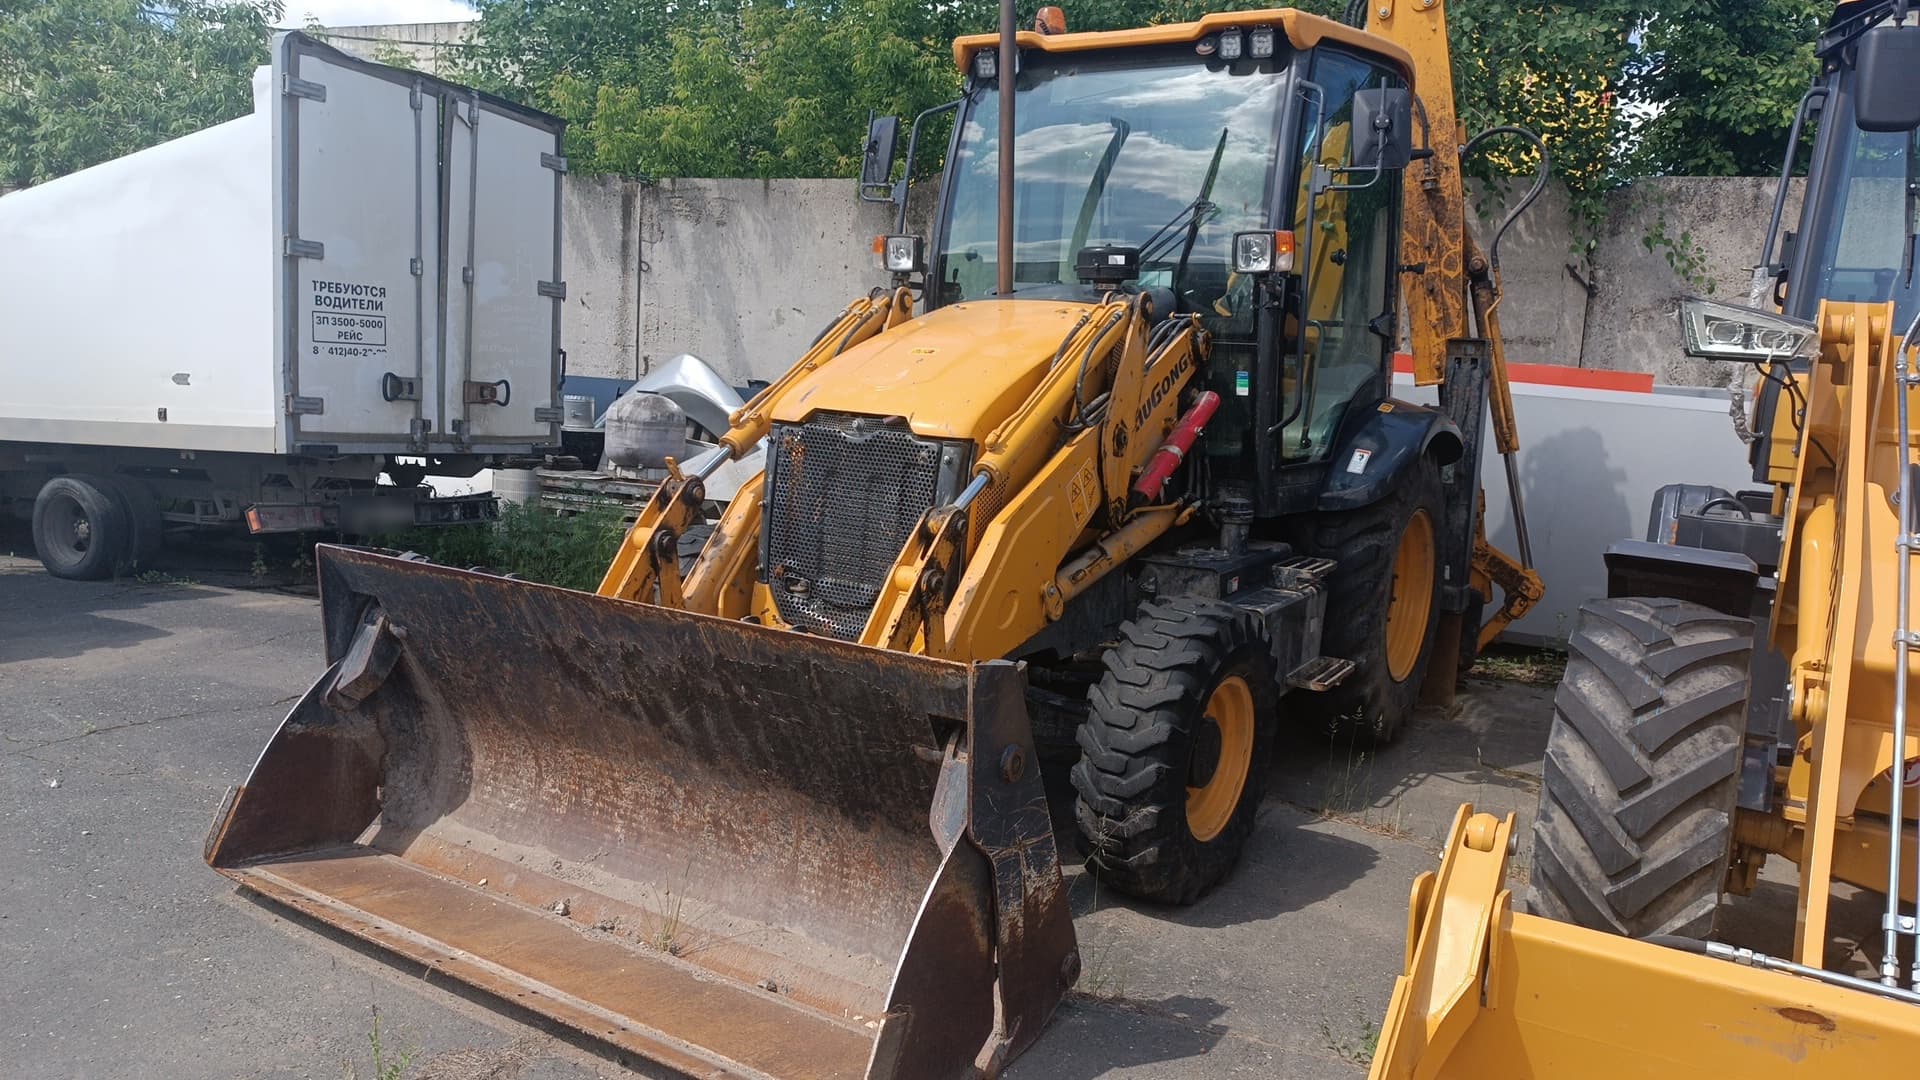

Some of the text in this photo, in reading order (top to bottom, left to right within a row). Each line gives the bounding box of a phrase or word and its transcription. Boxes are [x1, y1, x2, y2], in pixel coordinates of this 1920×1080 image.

[312, 280, 386, 298] ТРЕБУЮТСЯ
[315, 295, 383, 311] ВОДИТЕЛИ
[331, 317, 383, 329] 3500-5000
[337, 330, 363, 341] РЕЙС
